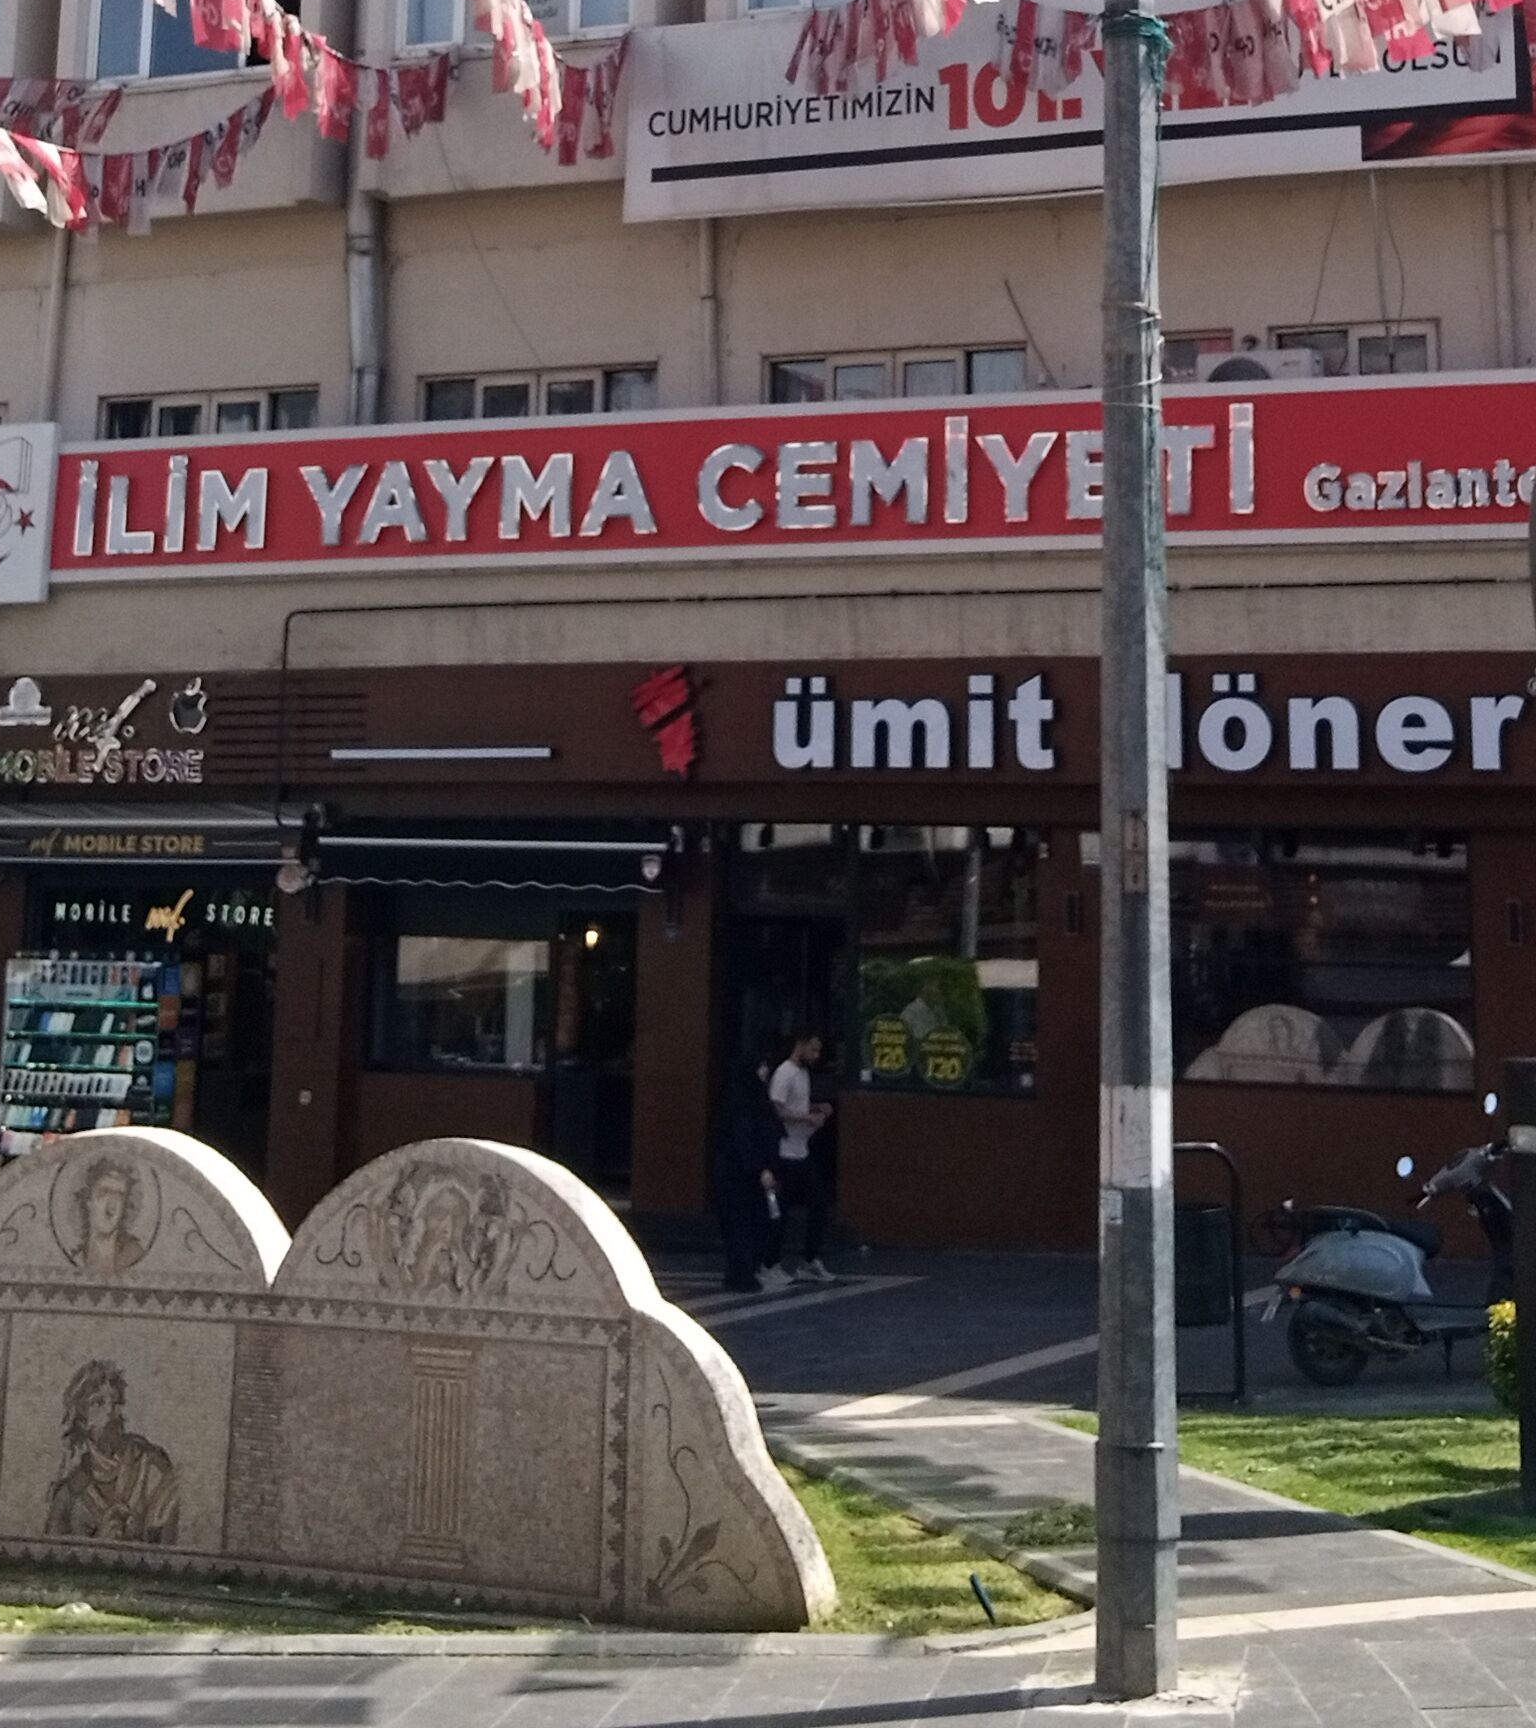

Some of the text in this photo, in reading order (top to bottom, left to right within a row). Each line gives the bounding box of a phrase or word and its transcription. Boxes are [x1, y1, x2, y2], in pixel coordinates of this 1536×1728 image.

[72, 454, 269, 557] İLİM
[298, 448, 657, 548] YAYMA
[1304, 458, 1536, 512] Gaziante
[773, 673, 1525, 773] ümit öner
[140, 834, 206, 854] STORE
[206, 902, 276, 928] STORE
